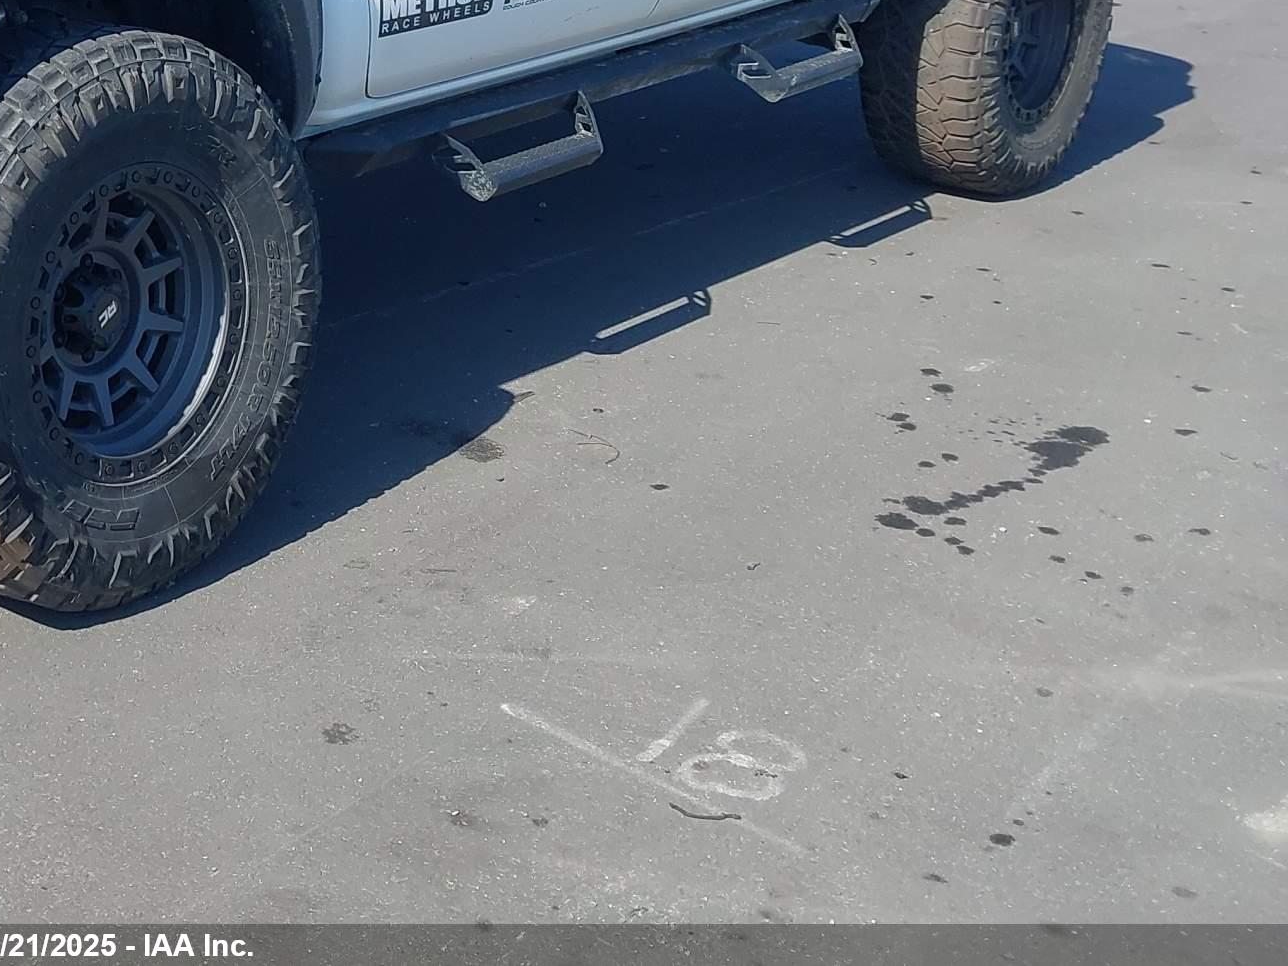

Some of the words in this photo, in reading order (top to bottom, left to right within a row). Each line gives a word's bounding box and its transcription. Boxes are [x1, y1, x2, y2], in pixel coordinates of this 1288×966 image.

[380, 15, 421, 35] RACE
[429, 0, 490, 23] WHEELS
[97, 299, 118, 330] RC
